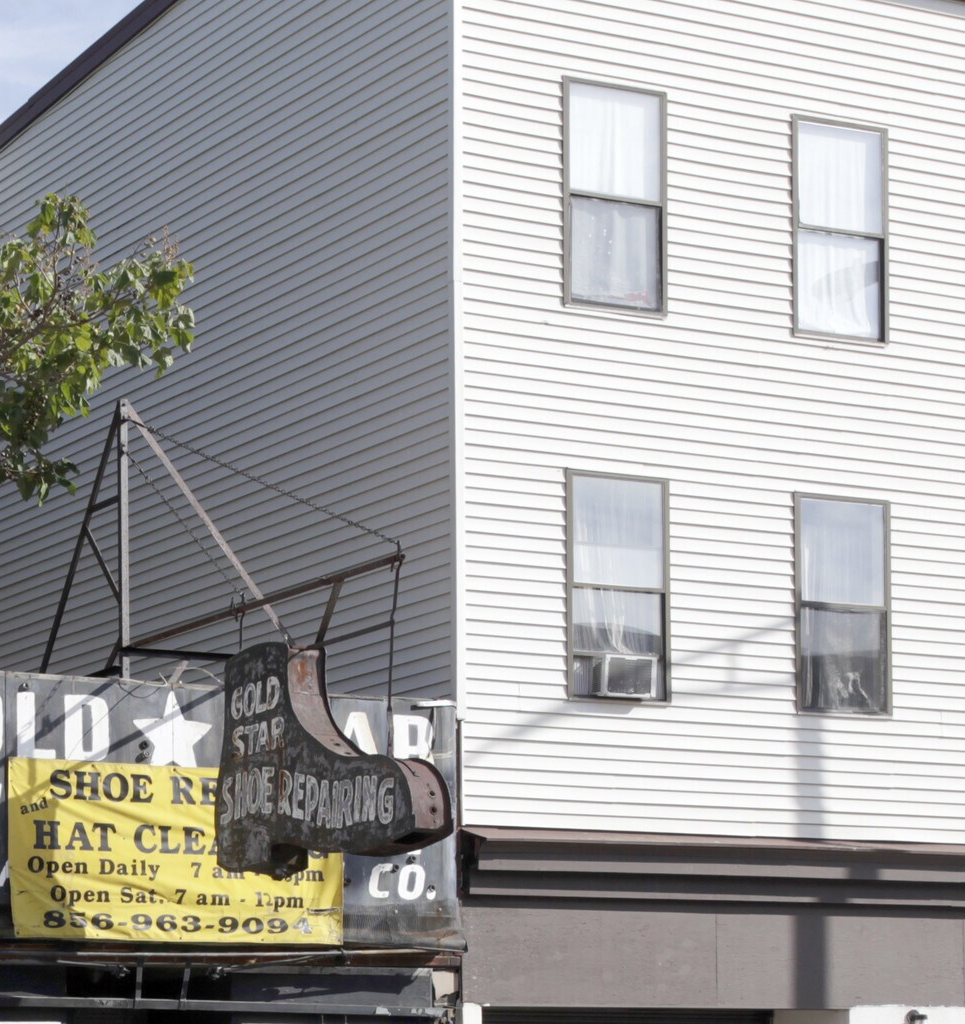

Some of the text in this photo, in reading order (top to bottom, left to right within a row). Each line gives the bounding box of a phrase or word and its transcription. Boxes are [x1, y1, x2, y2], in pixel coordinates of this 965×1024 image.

[230, 676, 281, 720] GOLD
[232, 716, 285, 759] STAR
[49, 769, 154, 803] SHOE
[219, 766, 275, 825] SHOE
[277, 769, 395, 829] REPAIRING
[20, 797, 49, 815] and
[33, 819, 117, 852] HAT
[28, 855, 88, 878] Open
[99, 858, 160, 880] Daily
[190, 862, 202, 878] 7
[368, 863, 437, 900] CO.
[50, 885, 110, 908] Open
[121, 885, 164, 904] Sat.
[175, 889, 187, 904] 7
[196, 893, 230, 906] am
[255, 891, 304, 912] 12pm
[43, 910, 313, 934] 856-963-9094
